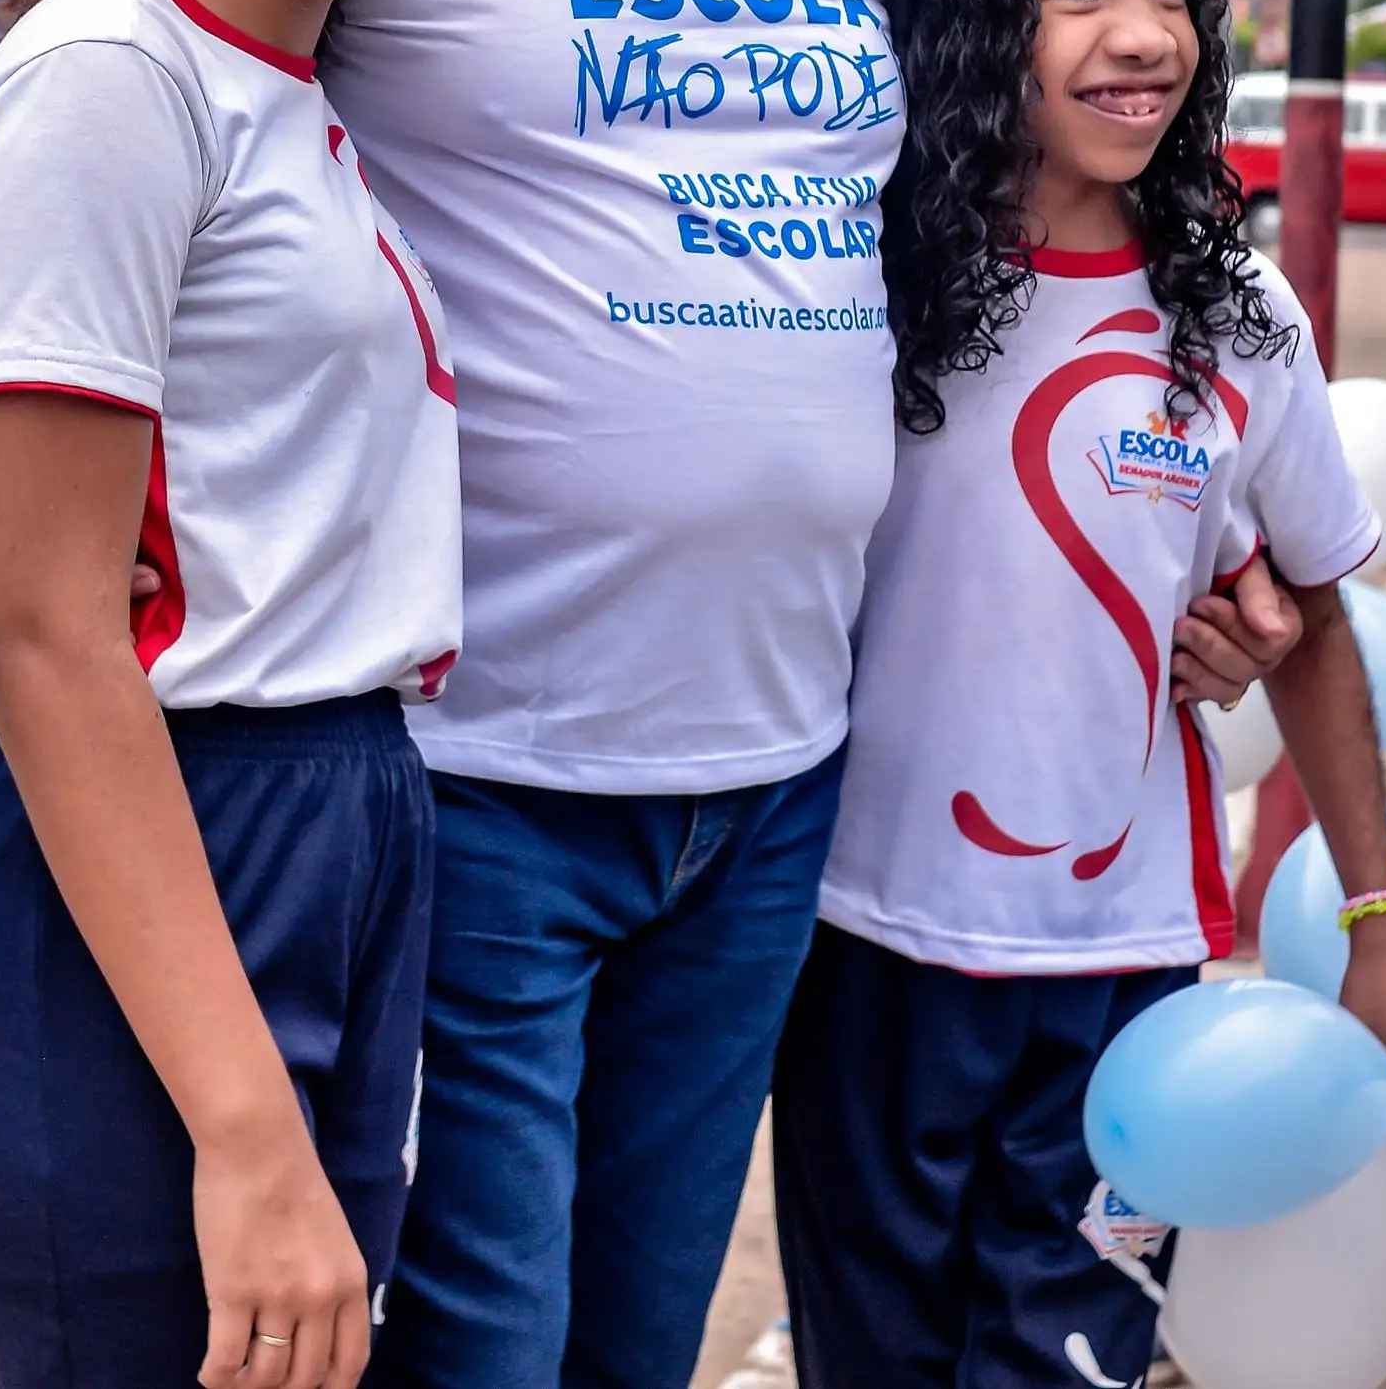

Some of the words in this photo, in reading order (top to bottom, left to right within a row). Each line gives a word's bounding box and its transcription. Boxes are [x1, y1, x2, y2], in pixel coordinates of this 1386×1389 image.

[571, 28, 727, 139] NÃO
[723, 42, 900, 131] PODE
[658, 173, 791, 213] BUSCA
[793, 174, 878, 211] ATIVA
[676, 211, 878, 260] ESCOLAR
[1120, 430, 1210, 471] ESCOLA
